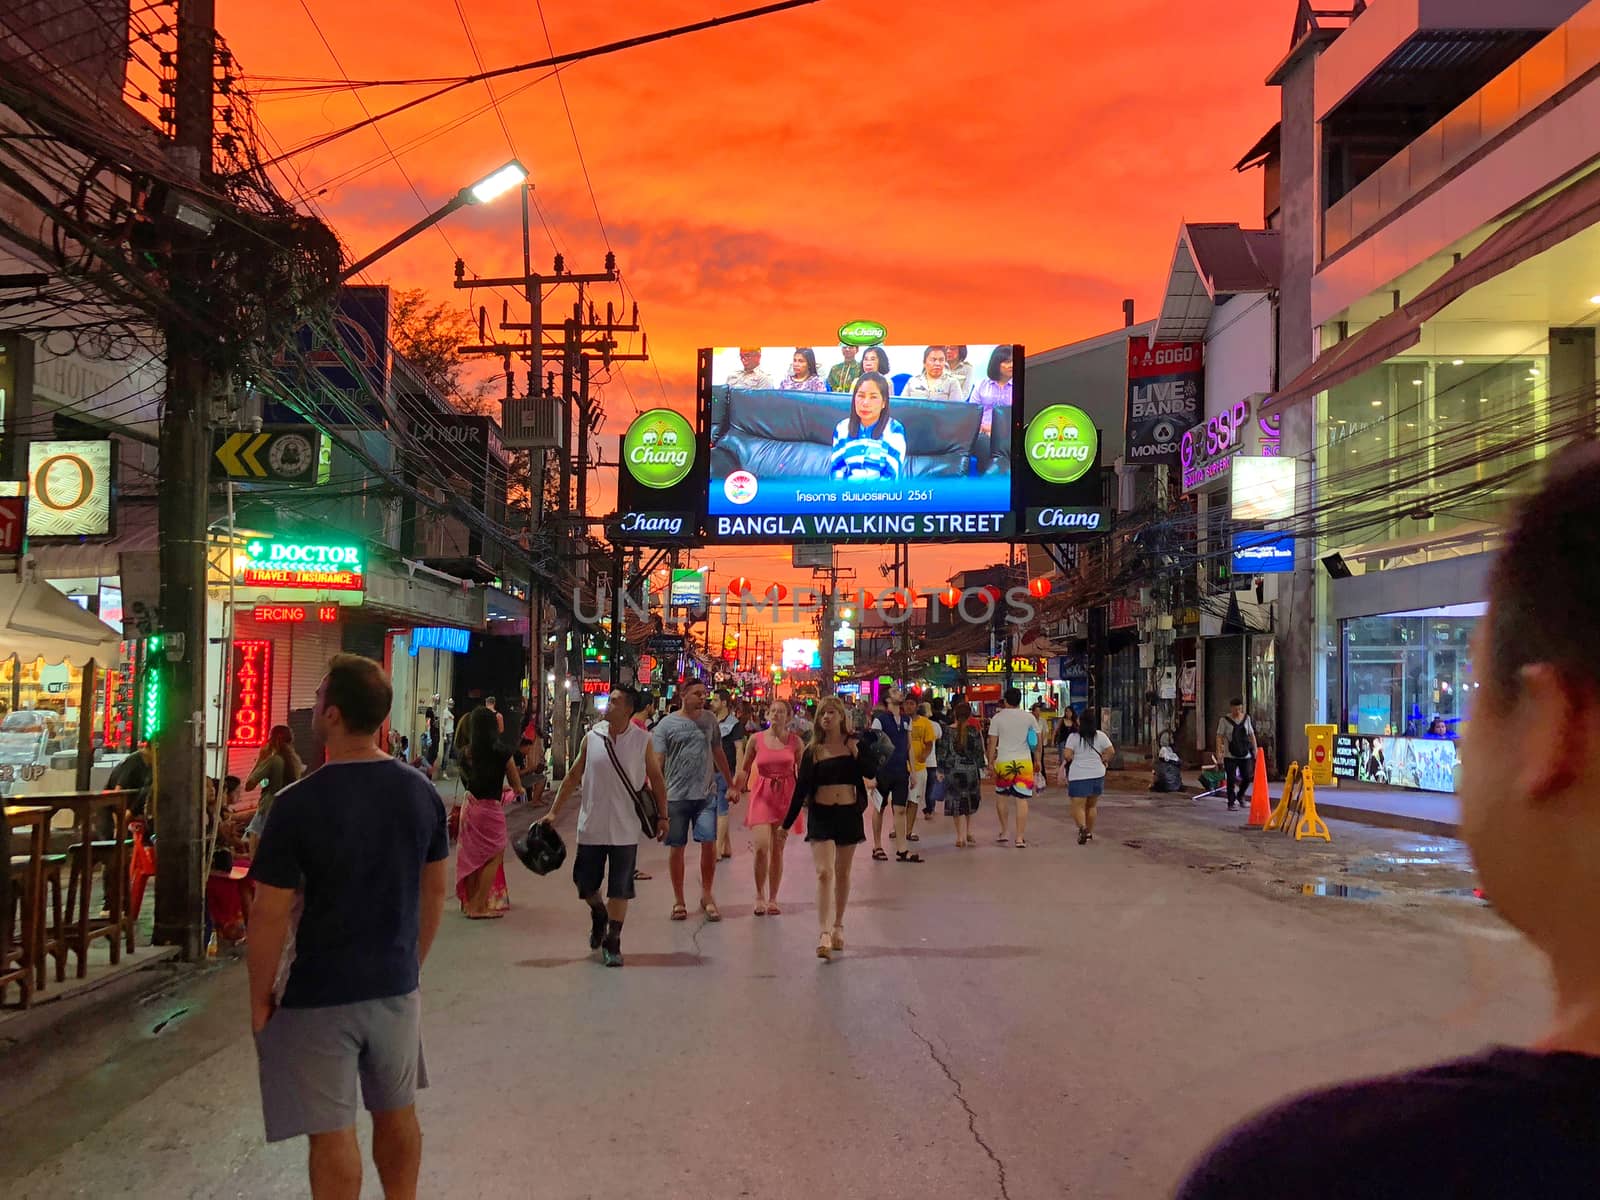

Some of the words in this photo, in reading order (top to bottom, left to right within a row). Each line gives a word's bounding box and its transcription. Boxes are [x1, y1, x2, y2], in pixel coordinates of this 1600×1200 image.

[855, 327, 883, 338] Chang
[1155, 347, 1193, 365] GOGO
[1133, 381, 1185, 404] LIVE
[1132, 398, 1197, 418] BANDS
[630, 446, 688, 467] Chang
[1031, 442, 1089, 461] Chang
[35, 454, 94, 511] O
[907, 488, 933, 501] 2561
[620, 512, 682, 534] Chang
[717, 516, 805, 535] BANGLA
[814, 515, 915, 535] WALKING
[922, 514, 1005, 533] STREET
[1038, 508, 1100, 529] Chang
[270, 543, 360, 563] DOCTOR
[252, 570, 290, 582] TRAVEL
[295, 570, 353, 584] INSURANCE
[236, 644, 259, 740] TATTOO
[22, 765, 46, 782] UP
